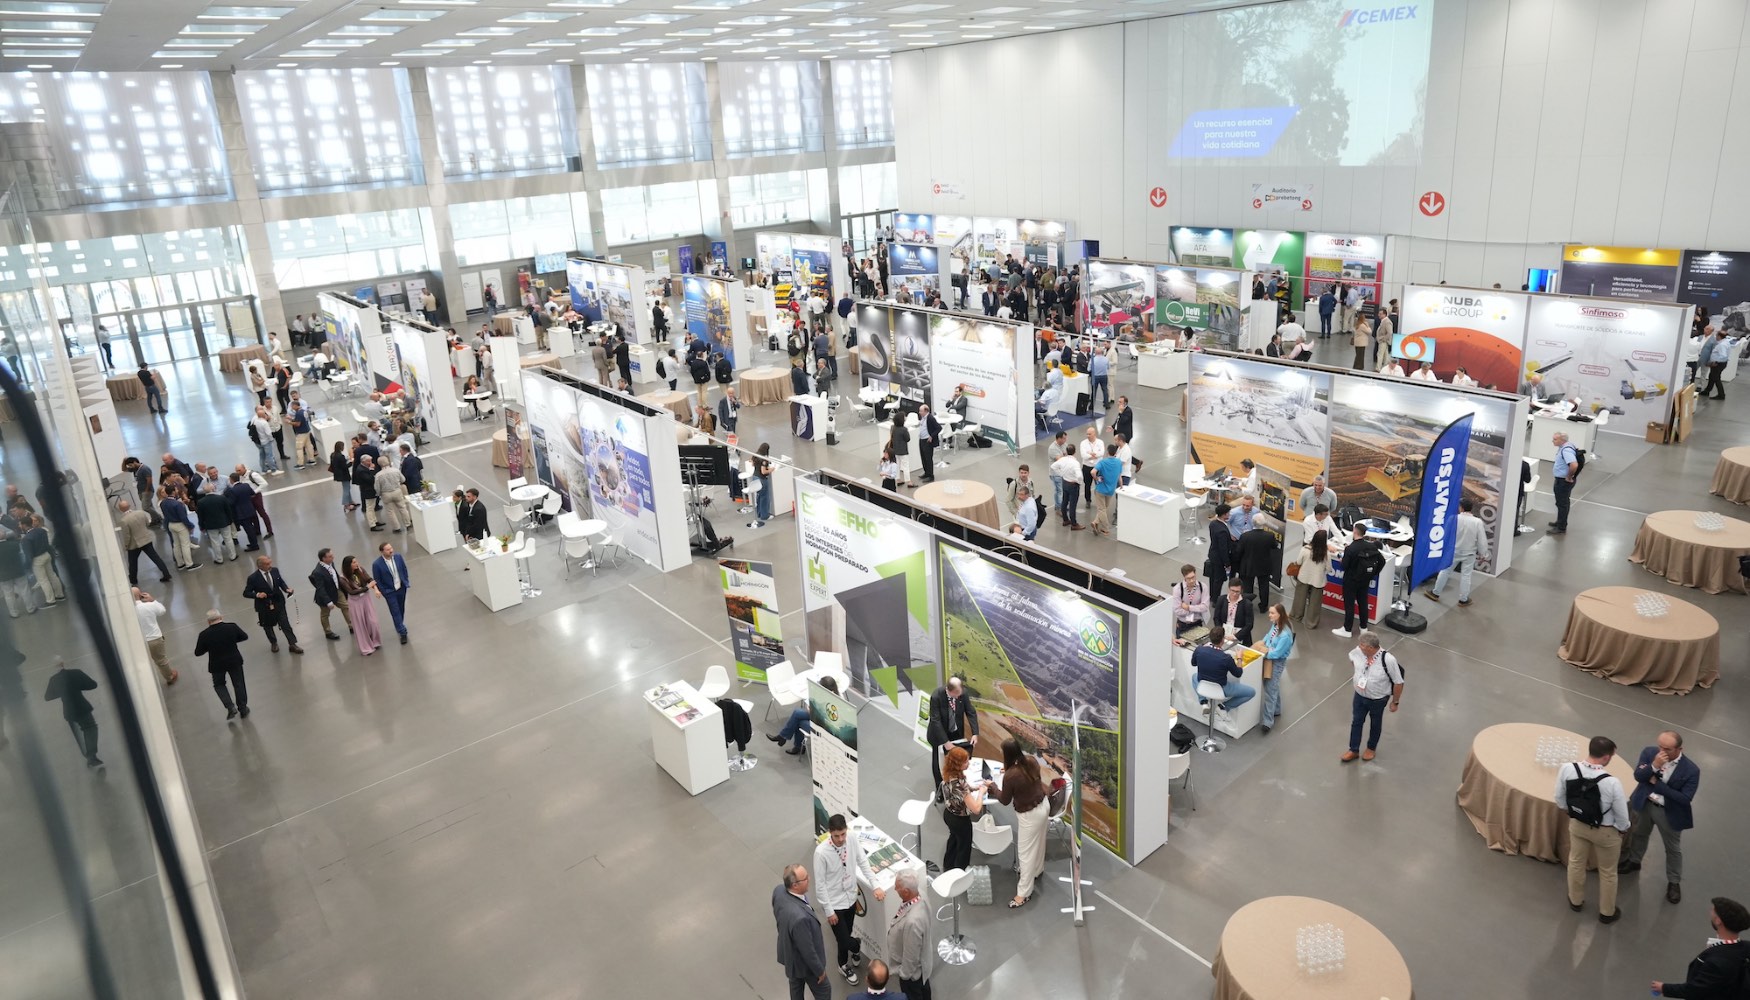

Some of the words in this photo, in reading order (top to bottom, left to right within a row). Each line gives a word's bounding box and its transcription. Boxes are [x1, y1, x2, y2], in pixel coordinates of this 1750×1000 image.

[1357, 5, 1418, 25] CEMEX
[1206, 120, 1236, 128] recurso
[1237, 117, 1273, 127] esencial
[1204, 130, 1223, 140] para
[1224, 130, 1257, 138] nuestra
[1202, 141, 1220, 150] vida
[1220, 140, 1260, 149] cotidiana
[1443, 296, 1484, 307] NUBA
[1442, 306, 1484, 318] GROUP
[1580, 307, 1625, 319] Sinfimasa
[1427, 447, 1456, 558] KOMATSU
[830, 529, 848, 542] AÑOS
[804, 532, 815, 541] LOS
[815, 536, 844, 555] INTERESES
[805, 539, 834, 557] HORMIGÓN
[834, 552, 869, 574] PREPARADO
[810, 582, 827, 598] EXPERT
[1014, 608, 1049, 628] restauración
